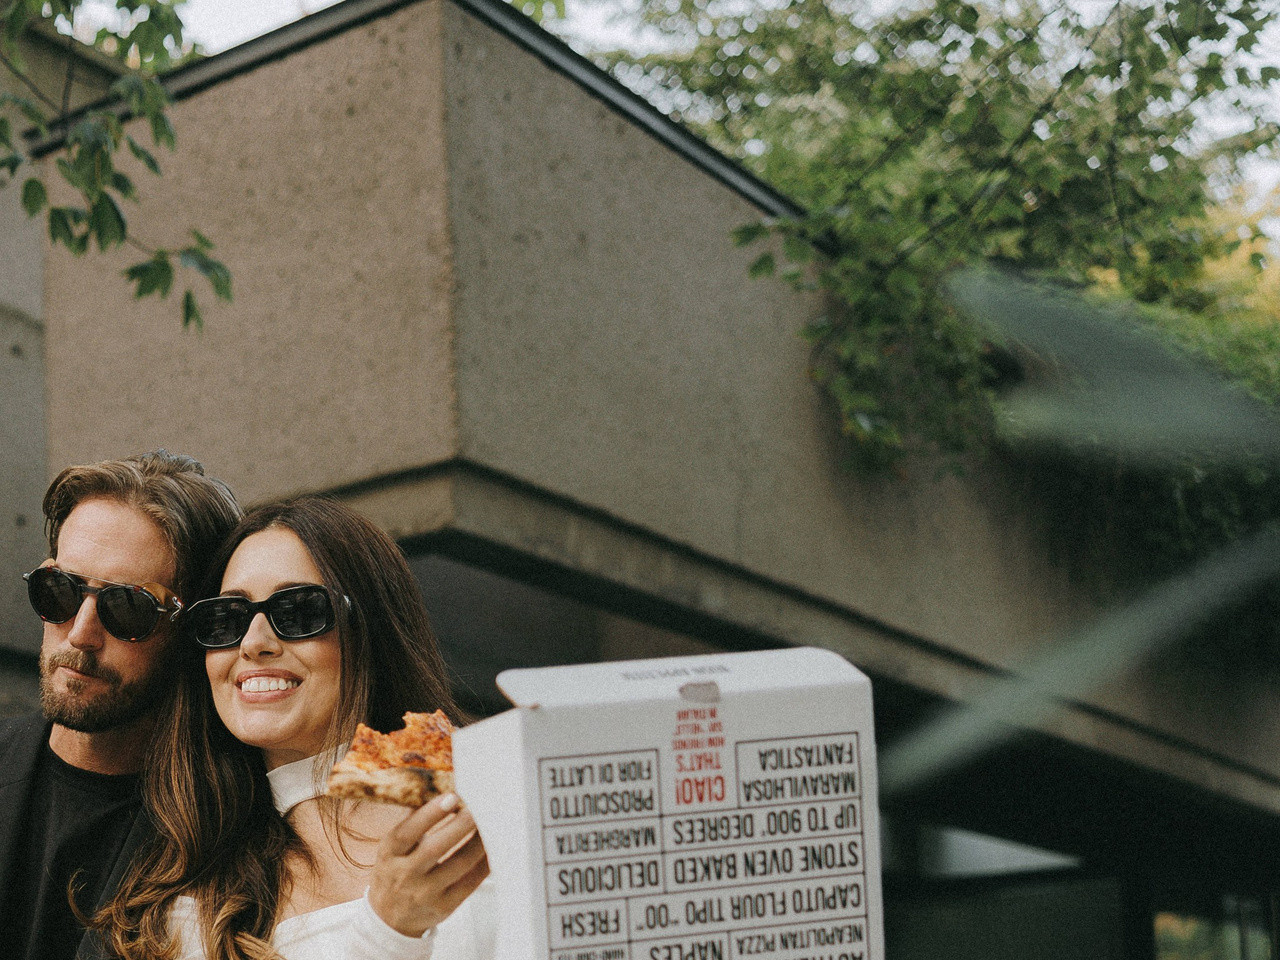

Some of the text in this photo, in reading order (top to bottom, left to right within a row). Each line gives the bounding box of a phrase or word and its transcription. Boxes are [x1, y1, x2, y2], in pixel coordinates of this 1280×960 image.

[758, 742, 853, 771] FANTASTICA
[549, 760, 651, 788] FIOR DI LATTE
[742, 772, 856, 801] MARAVILHOSA
[550, 788, 653, 819] PROSCIUTTO
[675, 775, 725, 804] CIAO!
[673, 813, 754, 845] DEGREES
[807, 807, 829, 831] TO
[834, 804, 857, 829] UP
[556, 827, 656, 855] MARGHERITA
[673, 841, 858, 884] STONE OVEN BAKED
[558, 860, 659, 895] DELICIOUS
[685, 896, 725, 925] TIPO
[730, 891, 787, 920] FLOUR
[792, 882, 861, 913] CAPUTO
[562, 909, 620, 938] FRESH
[736, 924, 863, 955] NEAPOLITAN PIZZA
